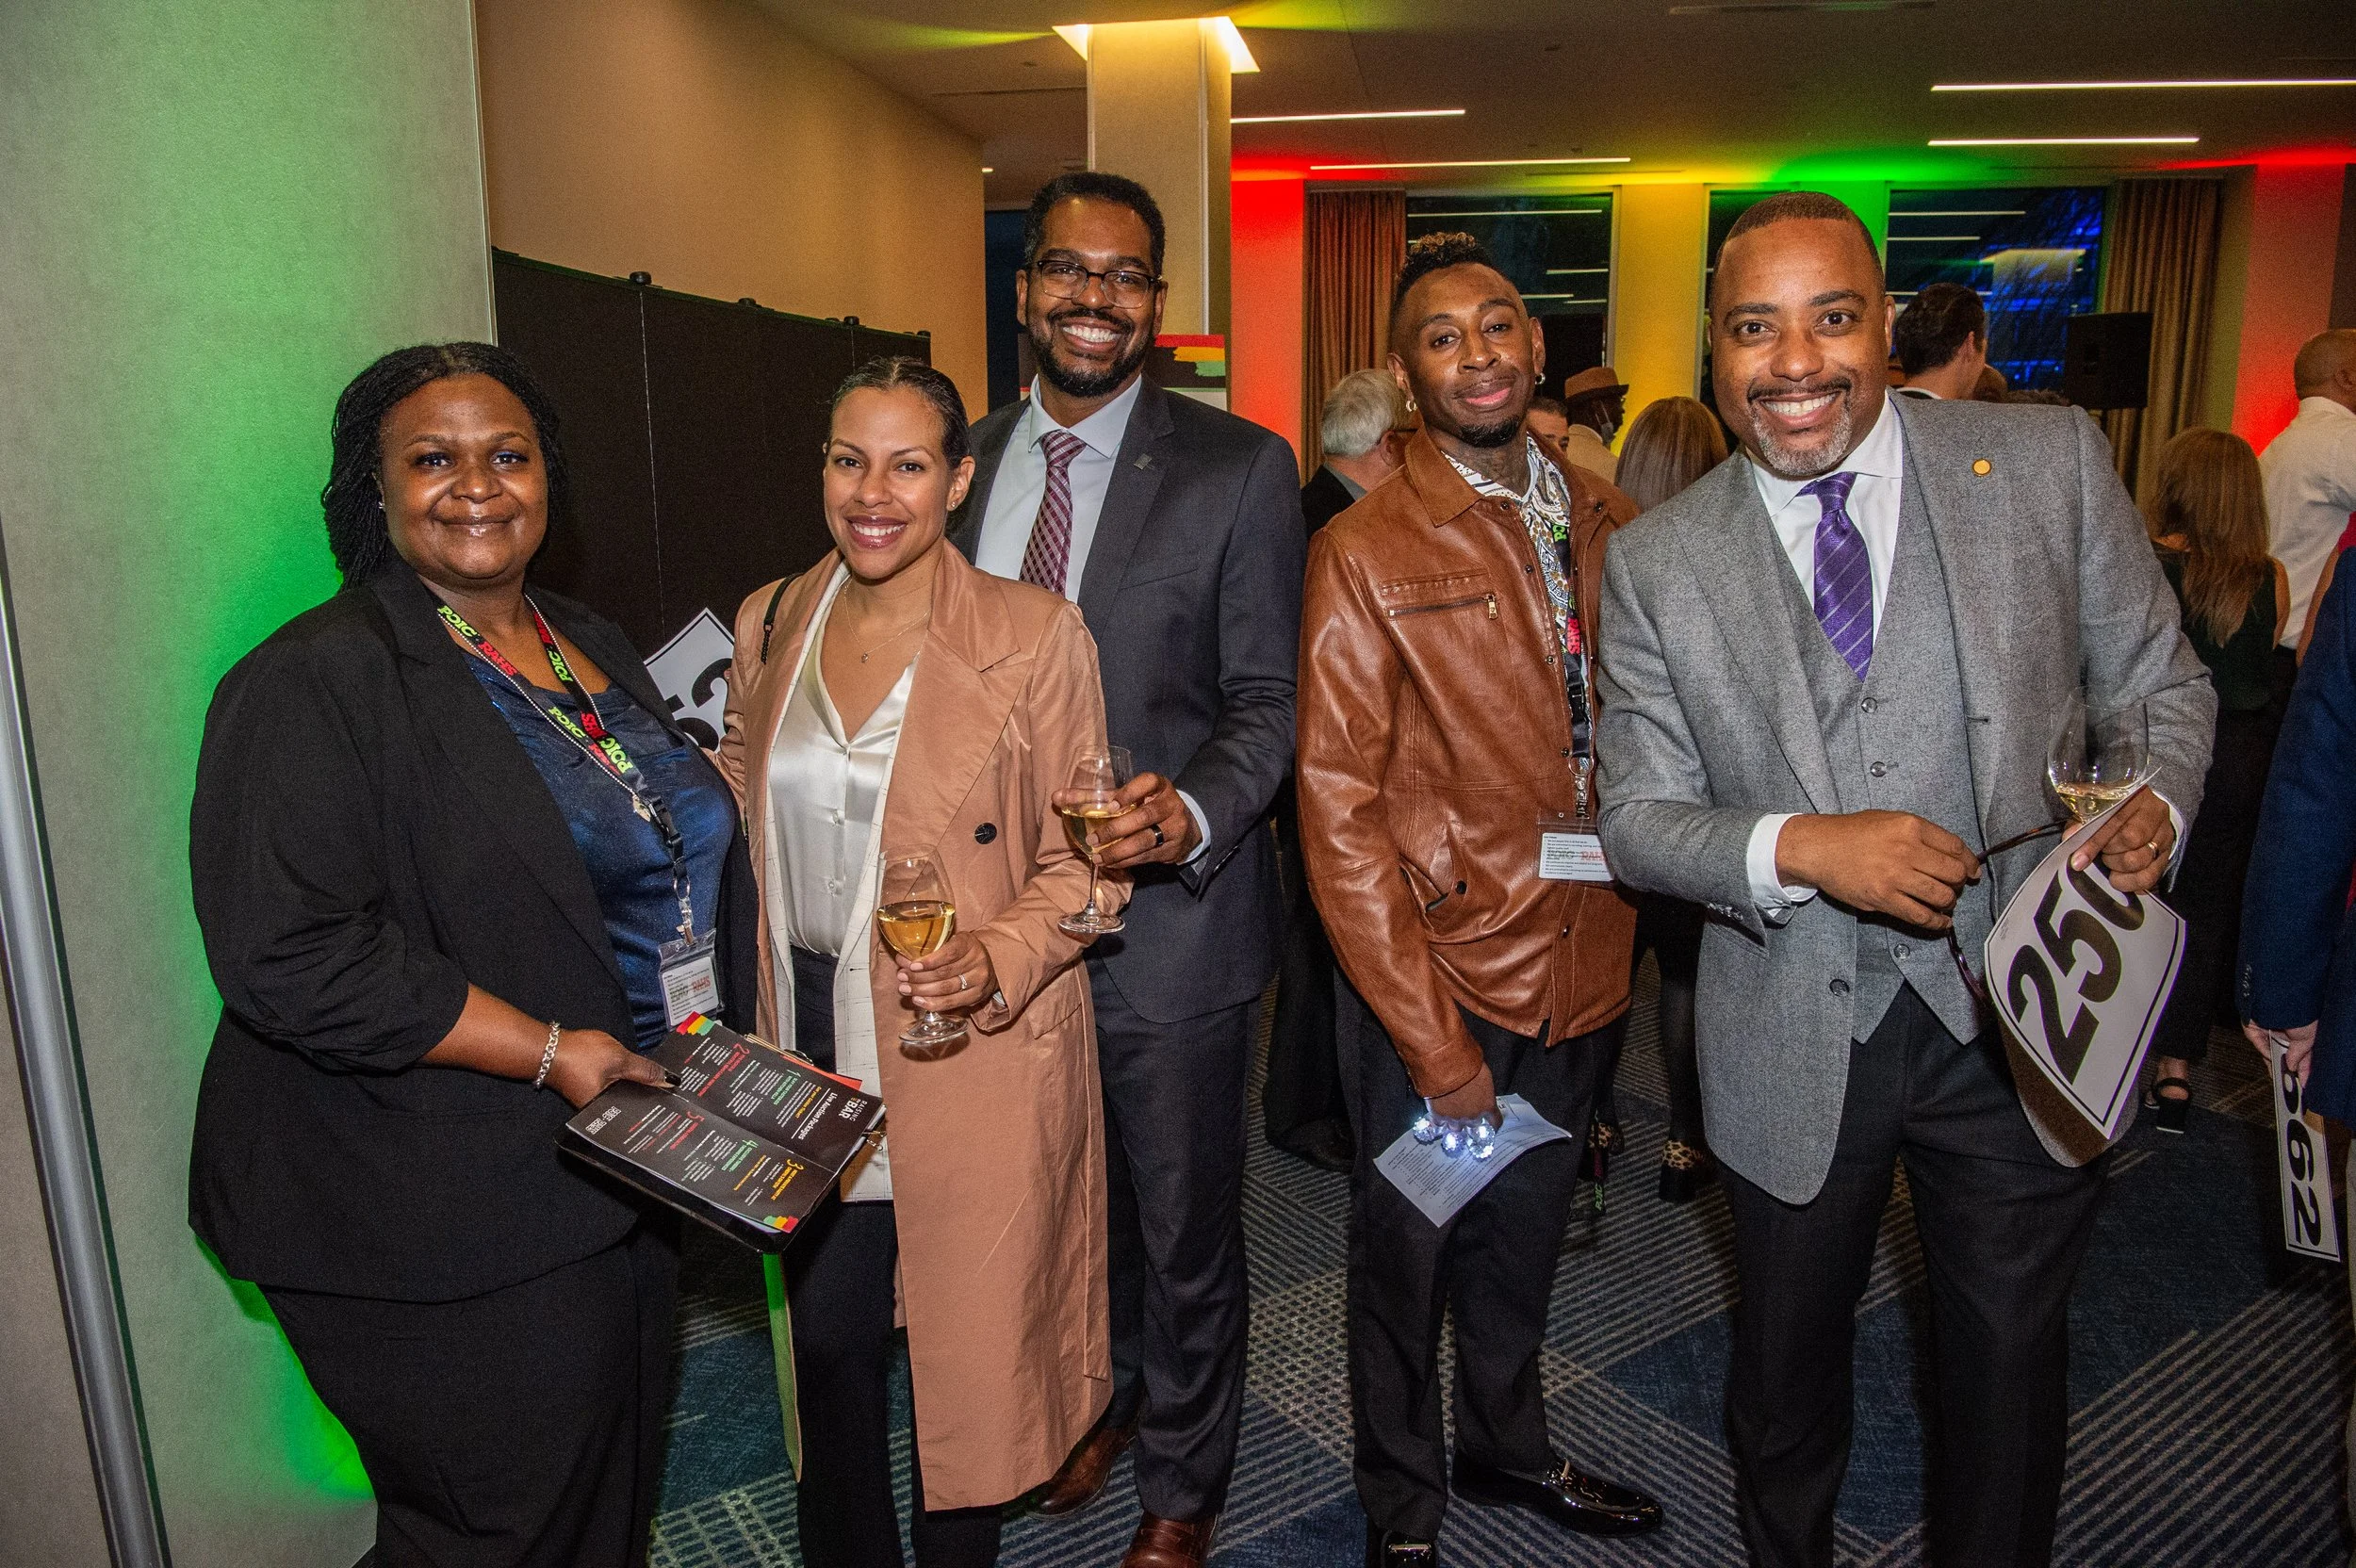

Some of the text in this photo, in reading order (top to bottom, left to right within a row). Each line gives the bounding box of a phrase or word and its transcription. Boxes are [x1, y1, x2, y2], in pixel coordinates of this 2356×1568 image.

[437, 605, 518, 676] POIC RAHS
[1566, 617, 1581, 655] RAHS
[548, 650, 573, 682] POIC
[548, 707, 585, 739] POIC
[599, 738, 633, 774] POIC
[2007, 851, 2144, 1086] 250
[733, 1042, 750, 1055] 2
[686, 1111, 704, 1121] 5
[797, 1092, 838, 1140] Live Auction Packages
[838, 1100, 858, 1119] BAR
[849, 1100, 867, 1122] RAISING
[742, 1139, 759, 1148] 4
[786, 1158, 804, 1170] 3
